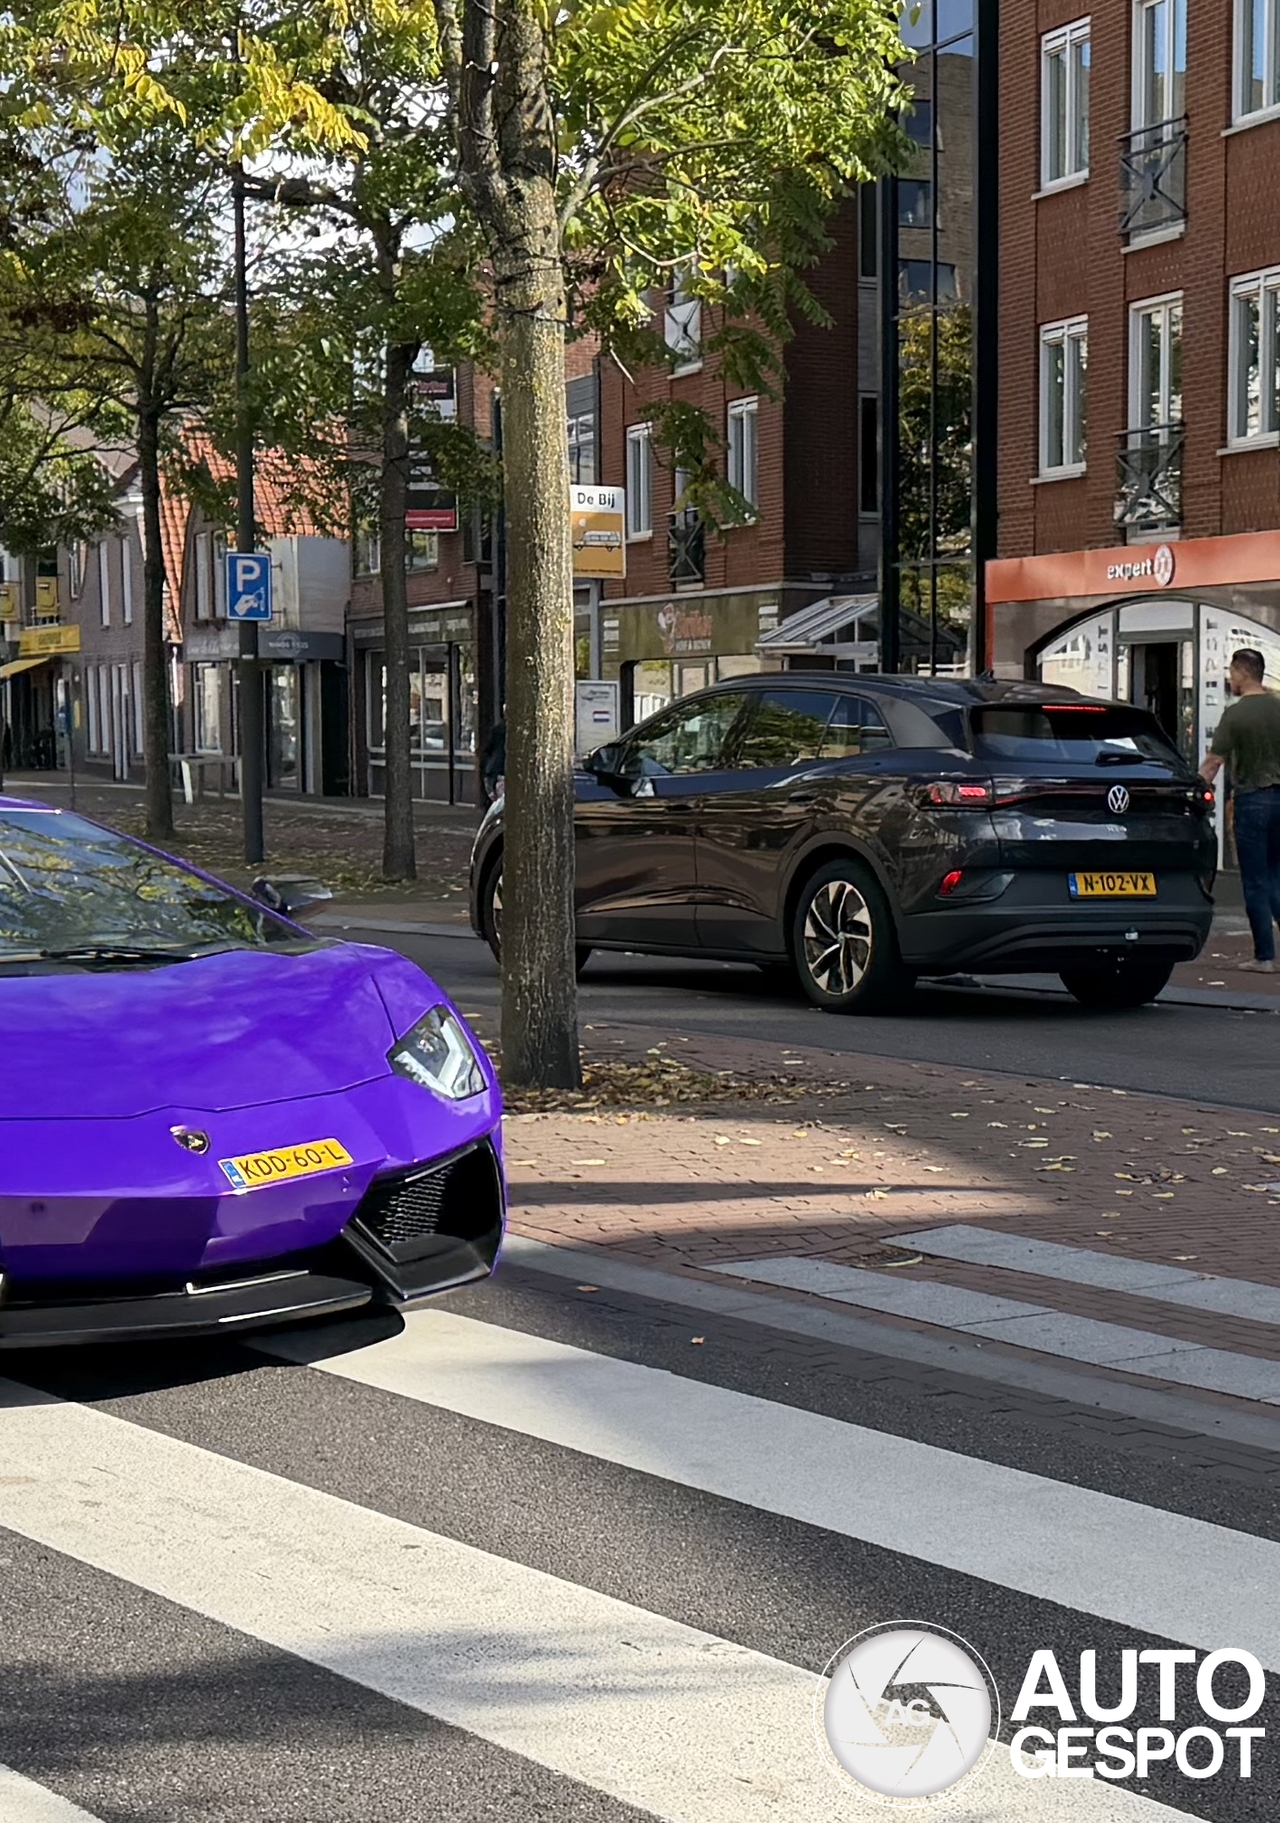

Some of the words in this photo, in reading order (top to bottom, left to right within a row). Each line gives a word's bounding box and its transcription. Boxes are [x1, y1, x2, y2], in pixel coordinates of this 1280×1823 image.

[577, 492, 594, 505] De
[598, 493, 615, 508] Bij
[236, 559, 261, 592] P
[1107, 558, 1152, 581] expert
[1083, 874, 1150, 892] N-102-VX
[239, 1145, 345, 1179] KDD-60-L
